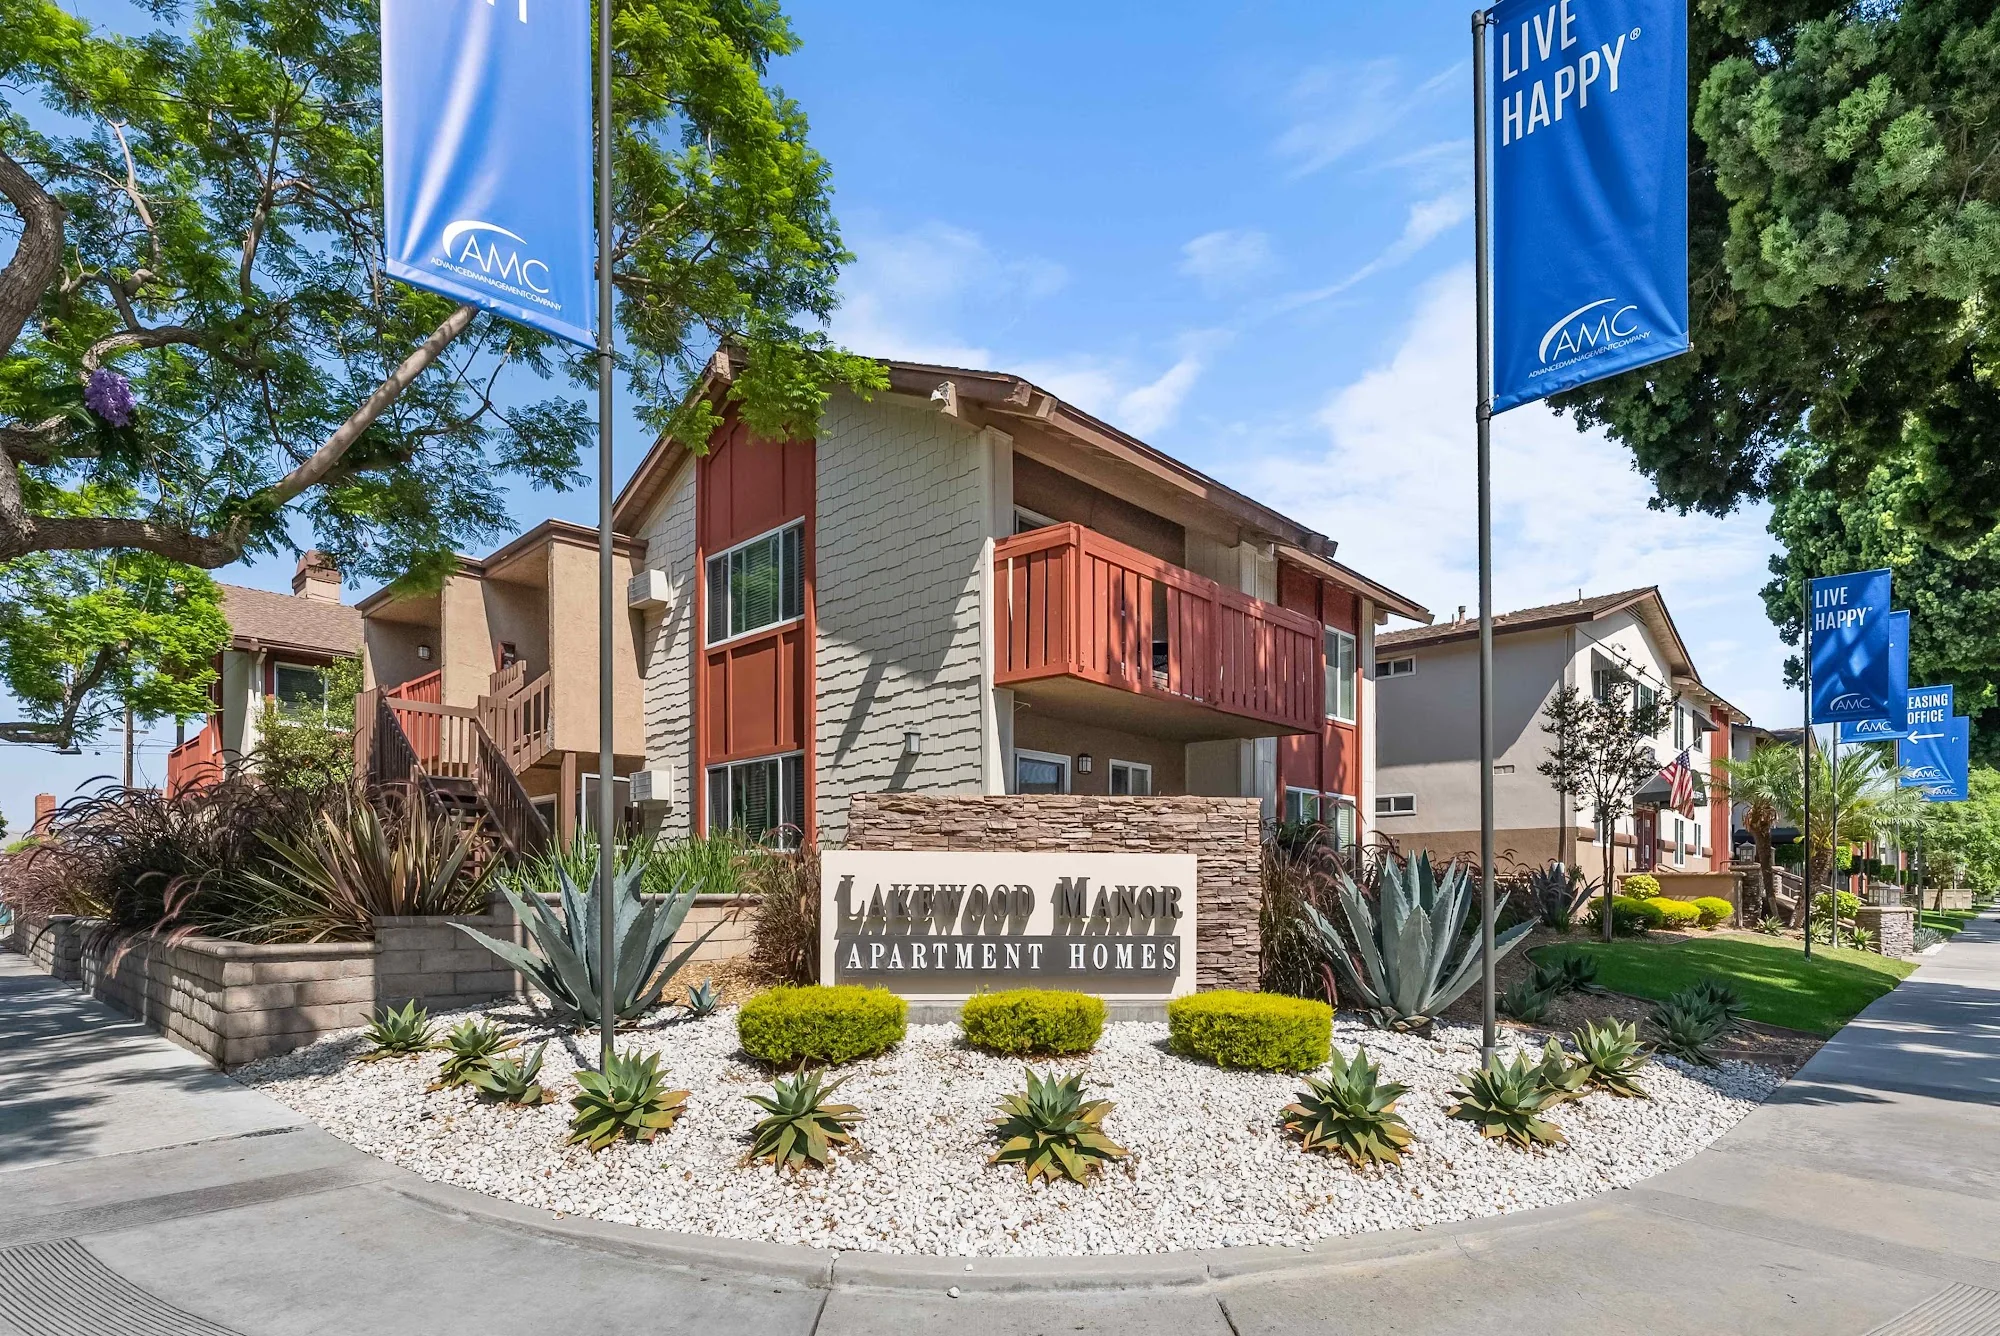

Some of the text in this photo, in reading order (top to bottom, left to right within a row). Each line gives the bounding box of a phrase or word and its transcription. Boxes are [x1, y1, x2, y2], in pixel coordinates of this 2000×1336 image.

[1503, 0, 1577, 82] LIVE
[460, 234, 549, 294] AMC
[1553, 305, 1638, 361] AMC
[1815, 586, 1848, 609] LIVE
[1836, 698, 1871, 711] AMC
[1907, 693, 1948, 709] EASING
[1861, 720, 1892, 733] AMC
[1907, 709, 1944, 725] OFFICE
[1917, 769, 1941, 778] AMC
[845, 942, 1177, 970] APARTMENT HOMES
